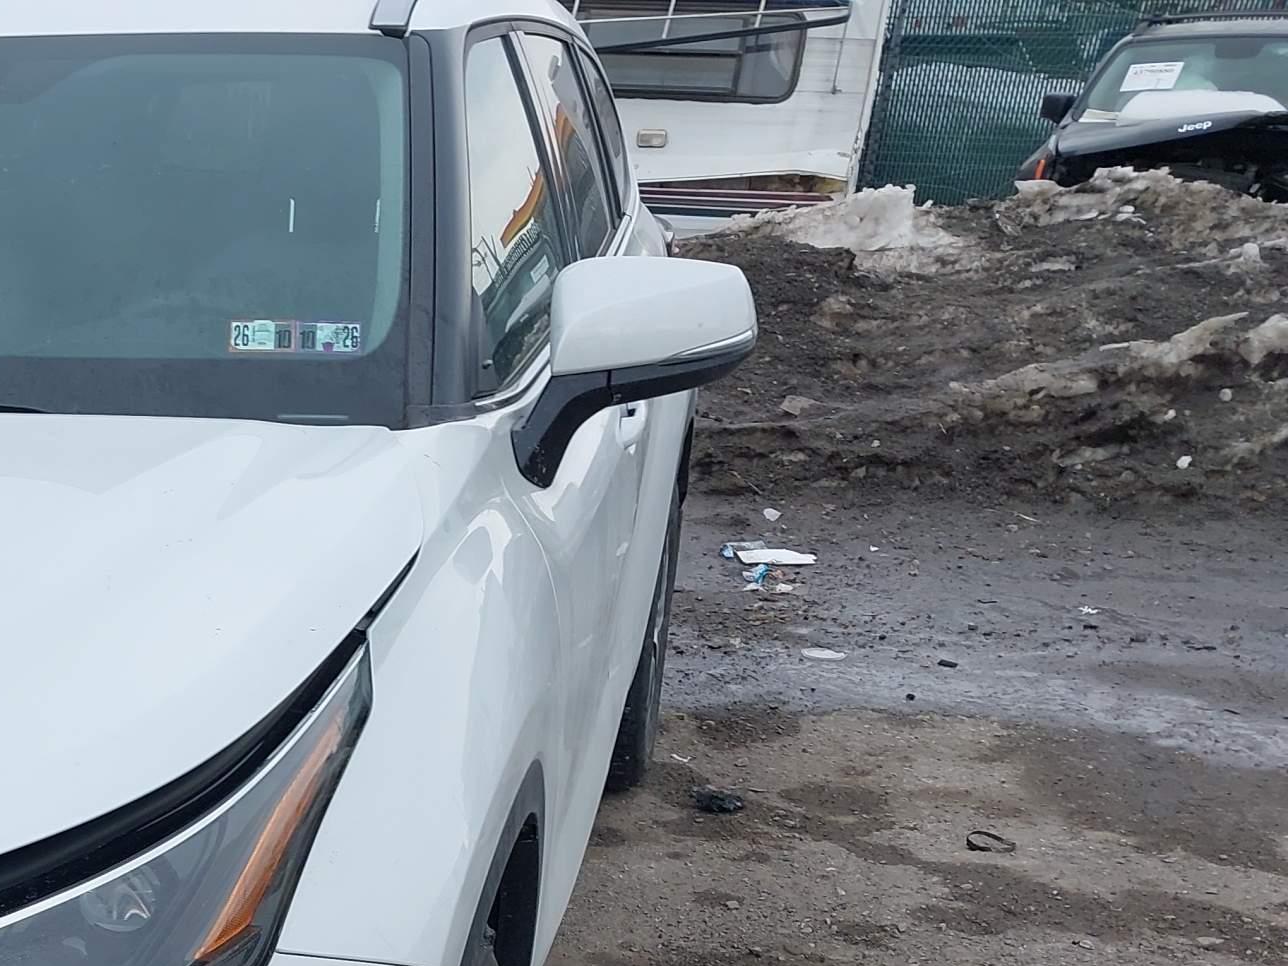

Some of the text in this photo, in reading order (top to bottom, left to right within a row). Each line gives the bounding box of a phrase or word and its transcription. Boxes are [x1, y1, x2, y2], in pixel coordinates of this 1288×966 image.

[1178, 120, 1213, 133] Jeep
[233, 324, 250, 347] 26
[342, 326, 359, 348] 26
